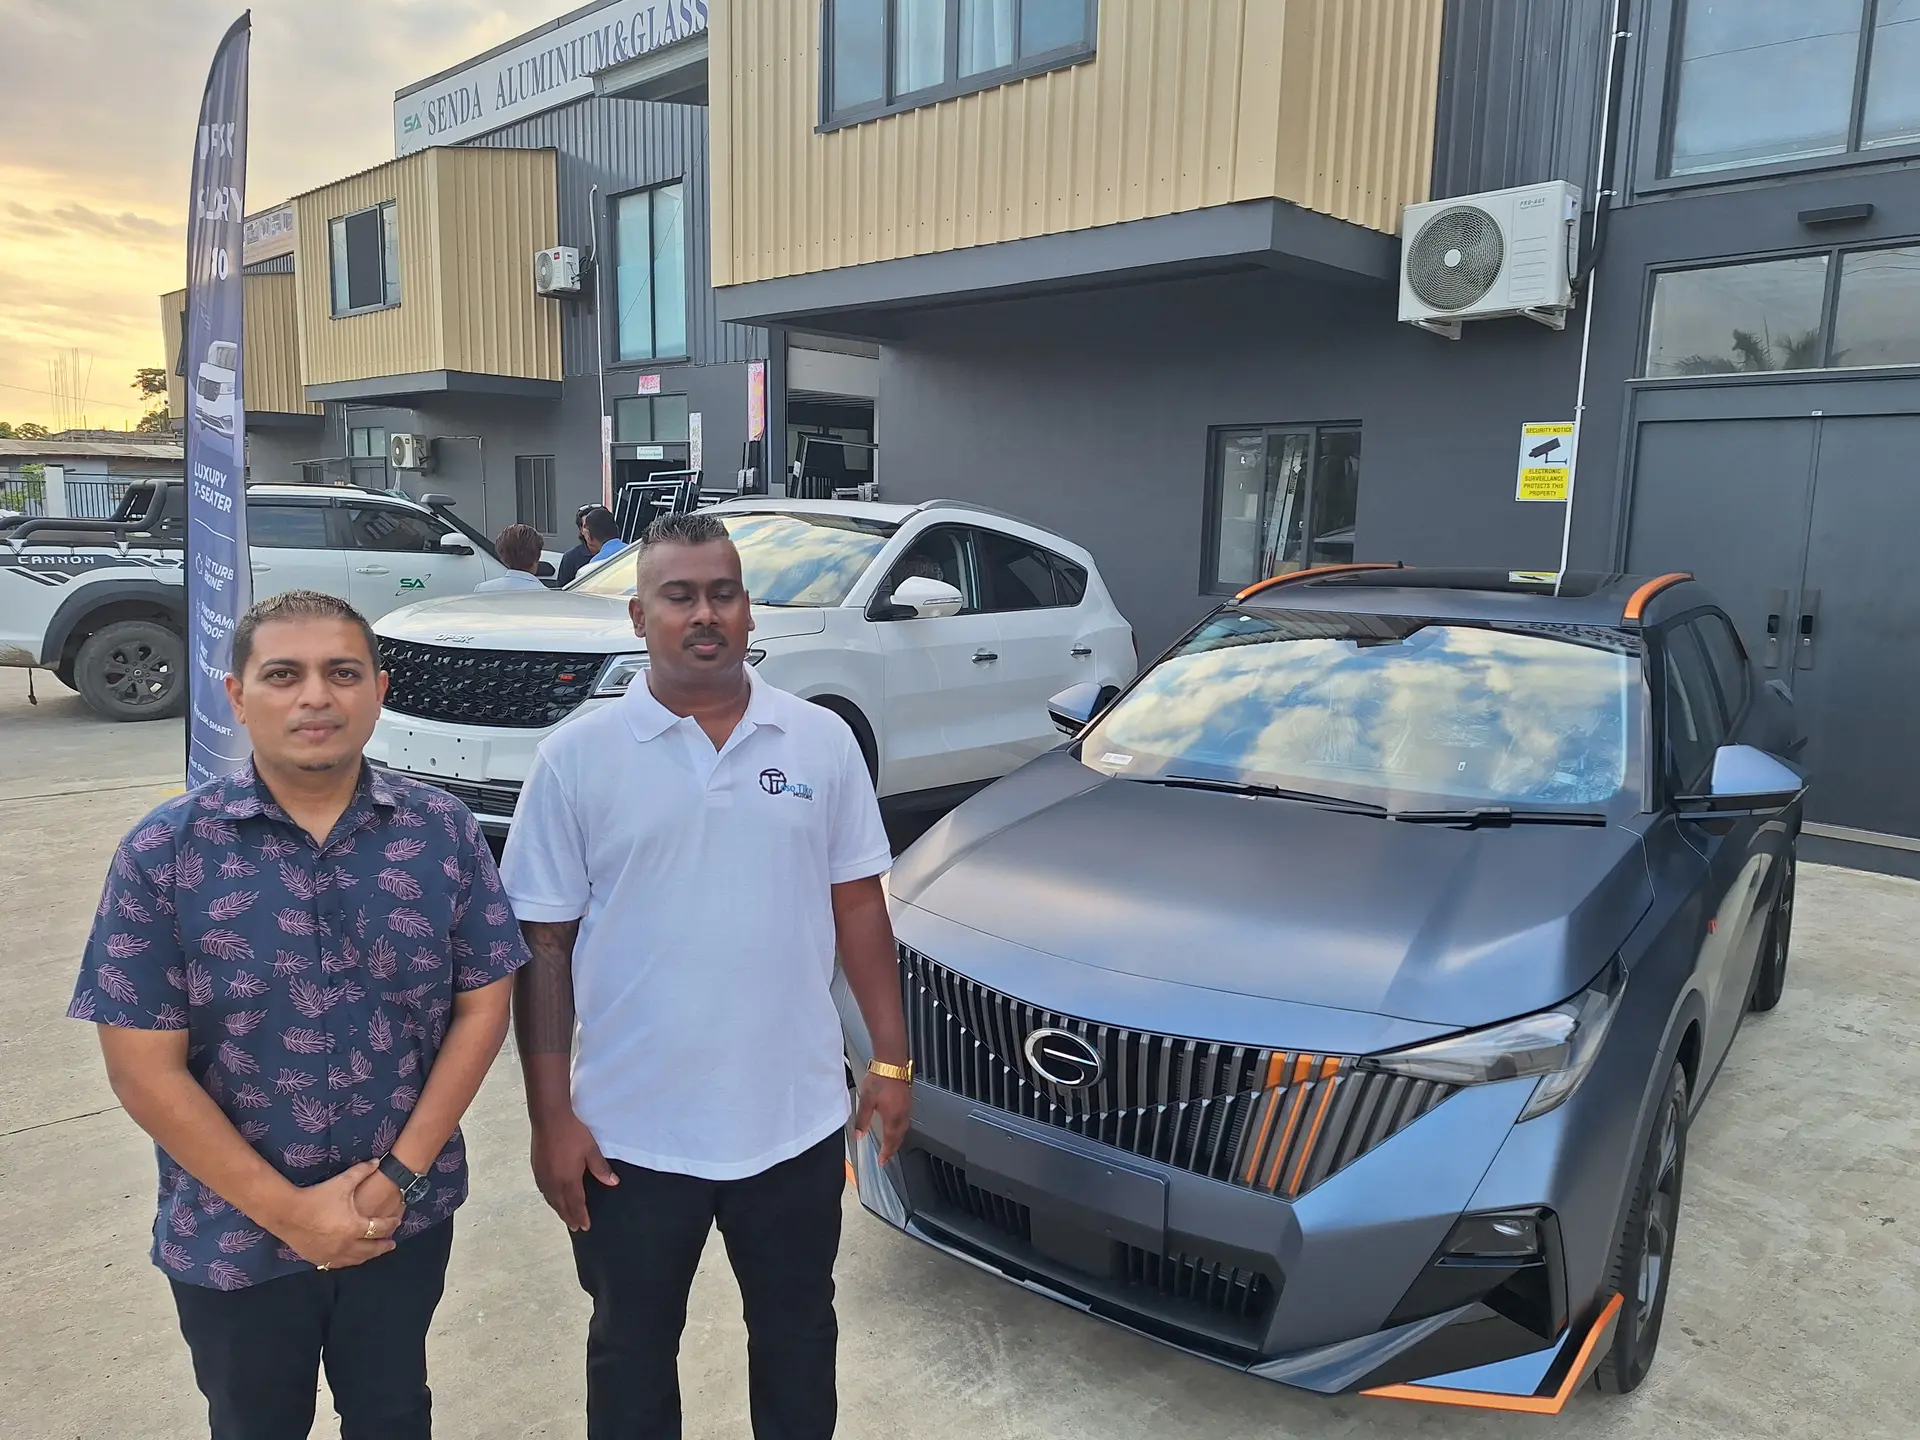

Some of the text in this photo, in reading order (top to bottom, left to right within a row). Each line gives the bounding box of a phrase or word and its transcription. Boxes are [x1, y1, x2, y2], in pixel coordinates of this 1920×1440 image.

[428, 82, 483, 136] SENDA
[194, 460, 227, 489] LUXURY
[194, 480, 232, 514] 7-SEATER
[17, 555, 95, 565] CANNON
[400, 578, 426, 589] SA
